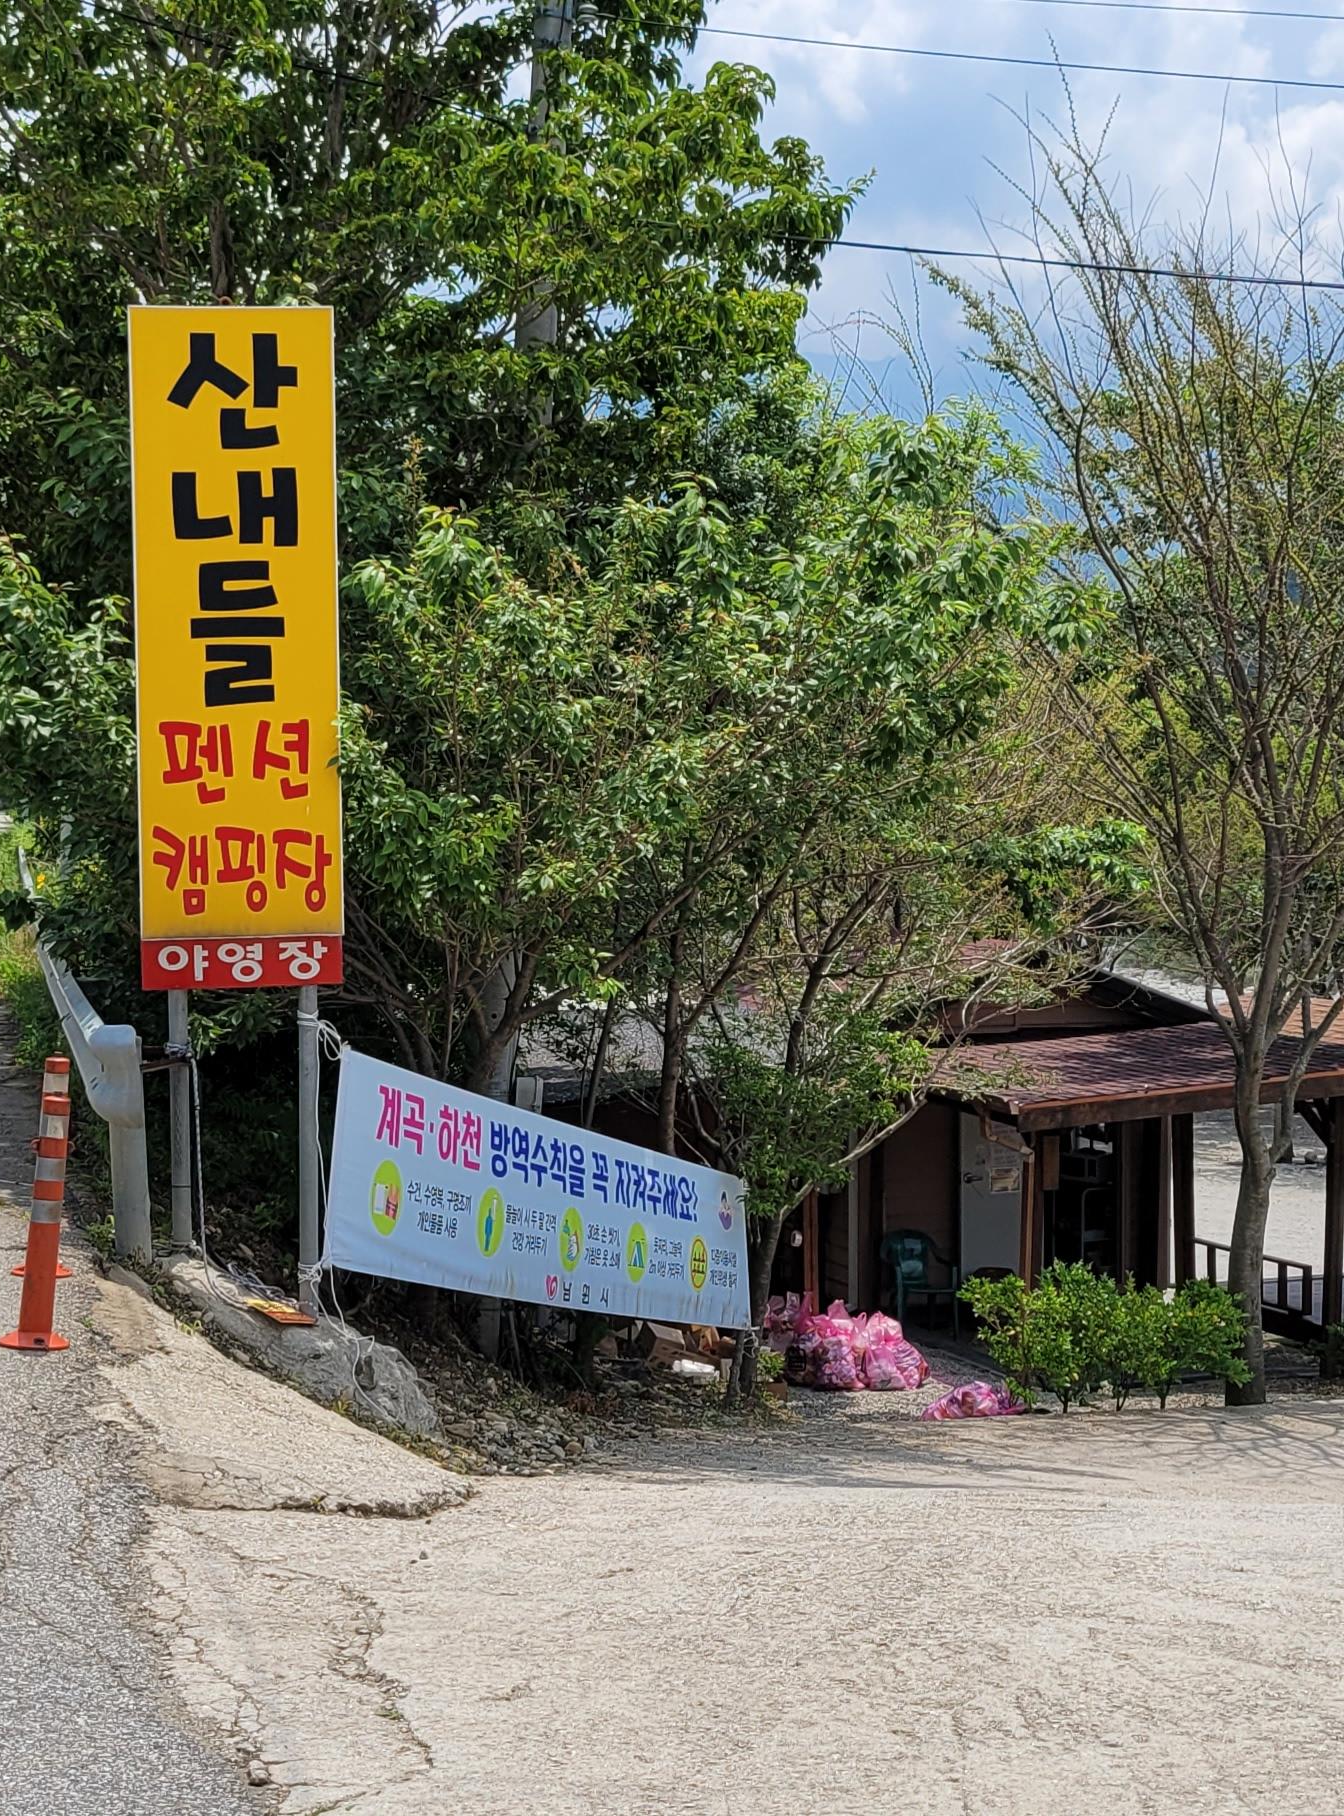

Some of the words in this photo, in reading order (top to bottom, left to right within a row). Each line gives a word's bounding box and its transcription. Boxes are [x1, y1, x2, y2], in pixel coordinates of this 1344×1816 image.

[166, 331, 300, 707] 산내들
[158, 718, 311, 804] 펜션
[152, 825, 333, 915] 캠핑장
[157, 940, 328, 983] 야영장
[490, 1120, 586, 1198] 방역수칙을
[592, 1151, 609, 1204] 꼭
[614, 1158, 698, 1222] 지켜주세요!
[446, 1190, 472, 1215] 구명조끼
[505, 1204, 523, 1227] 물놀이
[416, 1210, 444, 1236] 개인물품
[444, 1216, 458, 1239] 사용
[600, 1226, 608, 1244] 손
[512, 1232, 523, 1252] 건강
[524, 1233, 548, 1256] 거리두기
